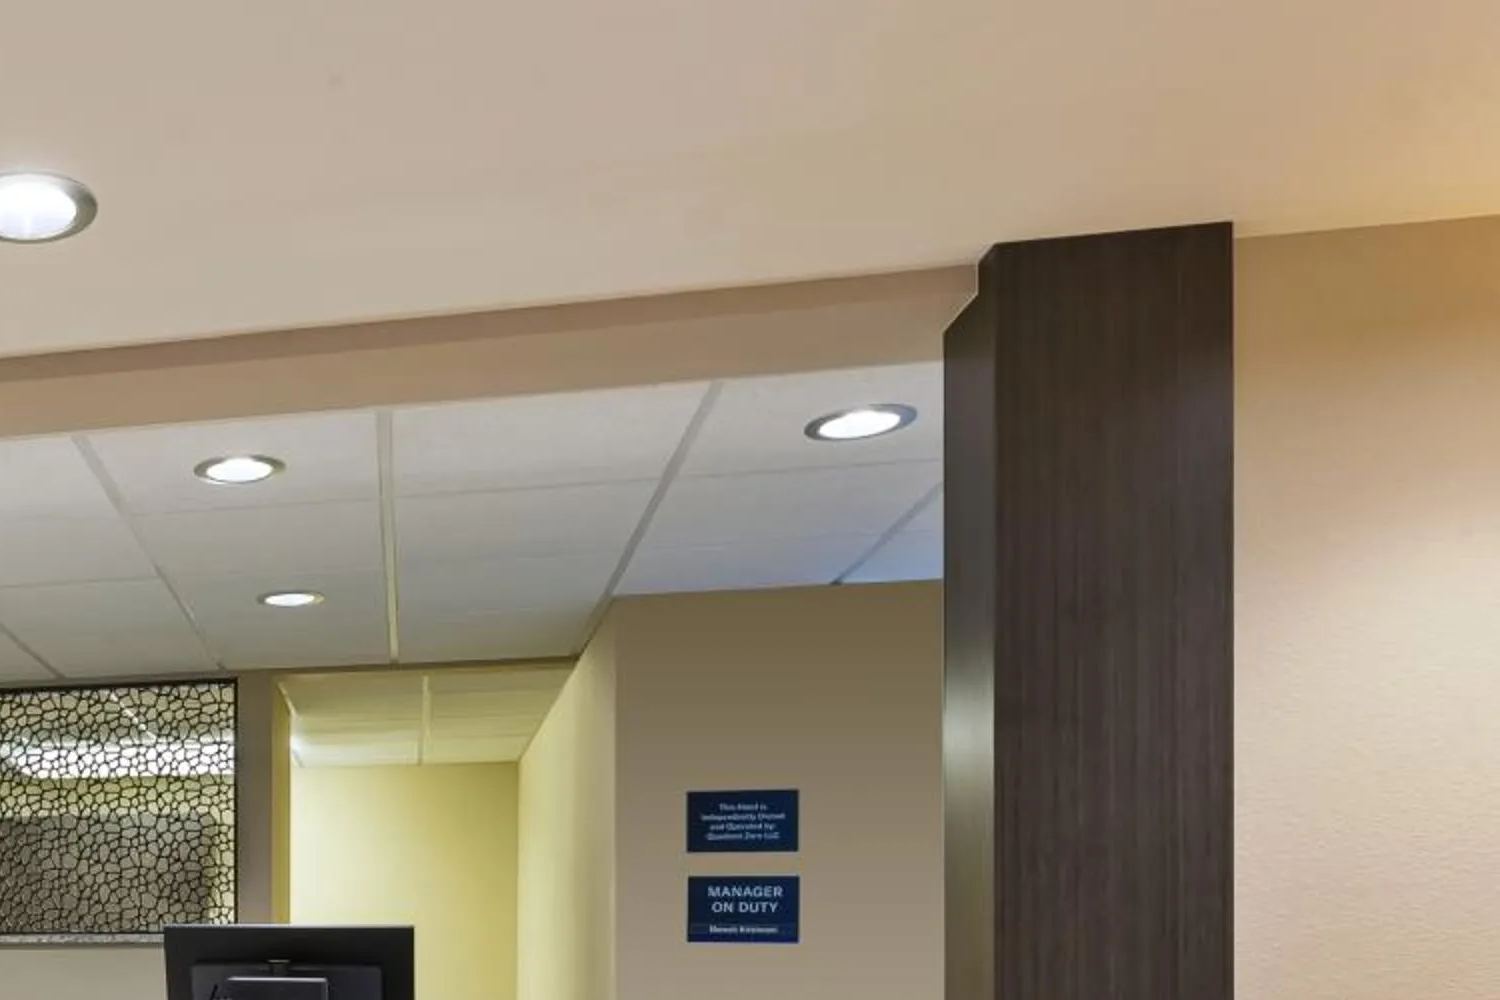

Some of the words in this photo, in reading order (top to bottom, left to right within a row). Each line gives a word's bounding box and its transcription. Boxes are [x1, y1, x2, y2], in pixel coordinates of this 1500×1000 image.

[707, 885, 784, 897] MANAGER
[711, 901, 734, 913] ON
[739, 901, 779, 913] DUTY
